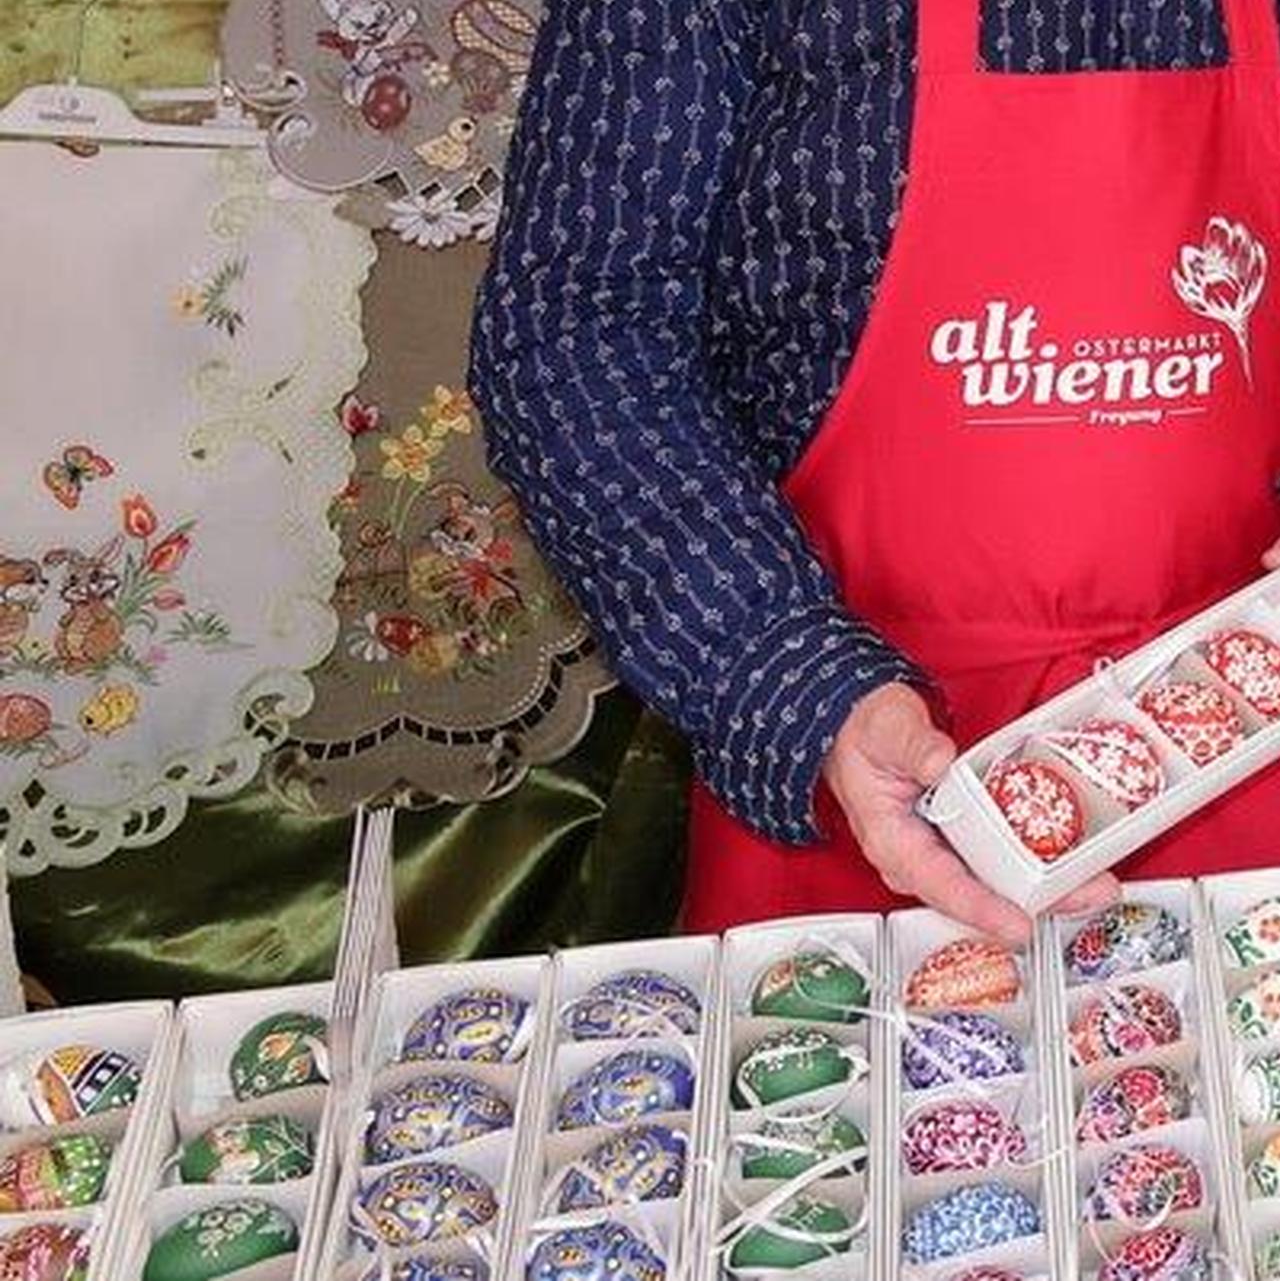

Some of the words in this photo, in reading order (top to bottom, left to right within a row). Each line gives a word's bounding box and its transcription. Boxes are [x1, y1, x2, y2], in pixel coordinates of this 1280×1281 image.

[930, 301, 1059, 363] alt.
[1073, 331, 1222, 358] OSTERMARKT
[960, 352, 1224, 406] wiener
